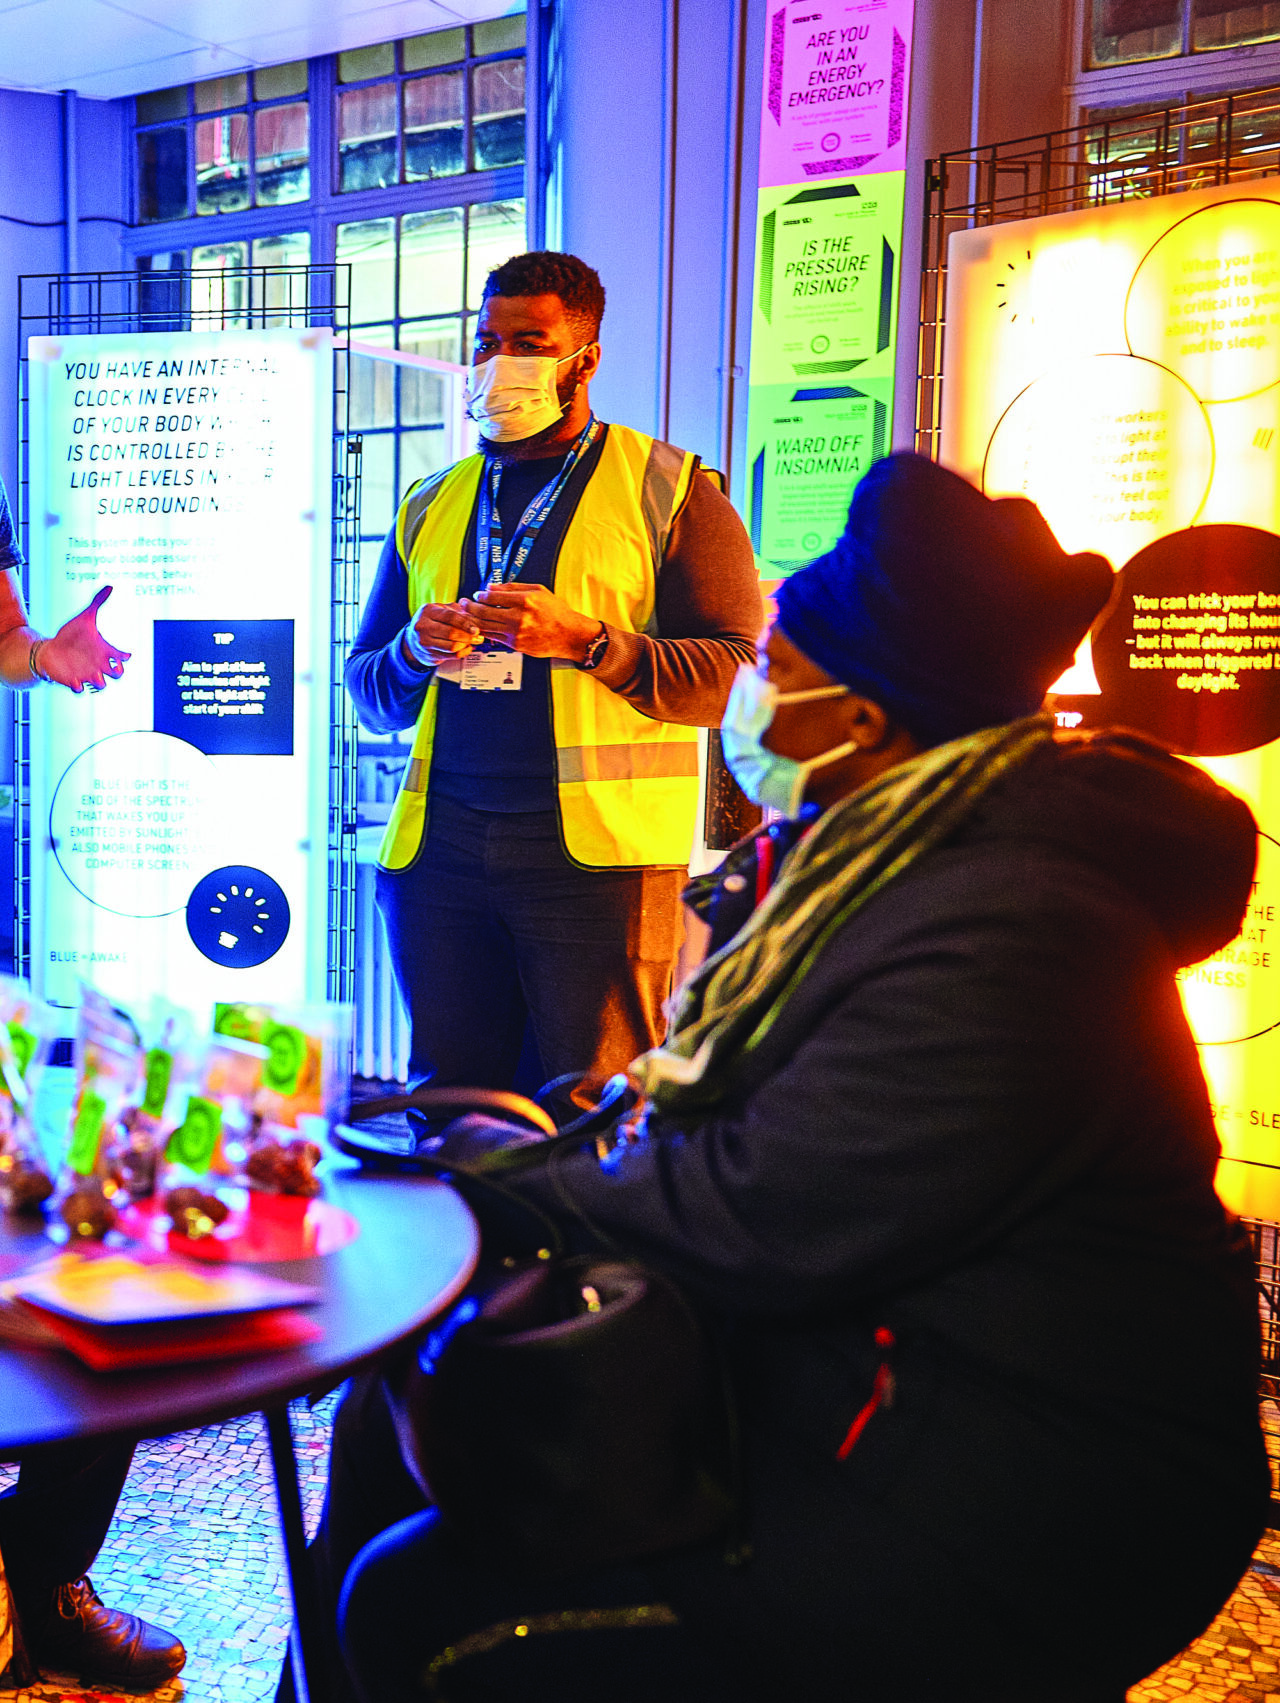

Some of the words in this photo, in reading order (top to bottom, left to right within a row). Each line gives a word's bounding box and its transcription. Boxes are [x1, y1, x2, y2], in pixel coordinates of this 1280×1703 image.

[806, 30, 836, 49] ARE
[840, 24, 870, 43] YOU
[817, 50, 834, 66] IN
[835, 46, 858, 62] AN
[808, 62, 867, 86] ENERGY
[788, 79, 884, 107] EMERGENCY?
[802, 240, 817, 256] IS
[823, 236, 854, 254] THE
[784, 254, 870, 278] PRESSURE
[1224, 255, 1250, 270] you
[792, 276, 860, 296] RISING?
[1234, 274, 1248, 286] to
[1184, 297, 1232, 314] critical
[1236, 296, 1250, 307] to
[1211, 318, 1224, 331] to
[1230, 314, 1266, 328] wake
[1180, 340, 1206, 356] and
[1209, 338, 1224, 352] to
[65, 362, 100, 380] YOU
[106, 361, 154, 378] HAVE
[156, 360, 184, 377] AN
[74, 390, 133, 406] CLOCK
[138, 388, 158, 404] IN
[163, 388, 218, 404] EVERY
[73, 417, 96, 434] OF
[102, 416, 148, 433] YOUR
[155, 415, 204, 432] BODY
[1115, 409, 1168, 423] workers
[67, 444, 83, 461] IS
[89, 442, 208, 460] CONTROLLED
[776, 436, 826, 454] WARD
[830, 434, 864, 452] OFF
[774, 456, 860, 476] INSOMNIA
[70, 471, 122, 488] LIGHT
[128, 470, 194, 486] LEVELS
[200, 469, 218, 486] IN
[1132, 470, 1142, 482] is
[98, 496, 241, 514] SURROUNDIN
[492, 546, 502, 563] NHS
[514, 546, 528, 568] NHS
[1133, 594, 1159, 610] You
[1160, 597, 1186, 610] can
[1188, 592, 1222, 610] trick
[1222, 595, 1256, 612] your
[1133, 614, 1161, 630] into
[1162, 613, 1228, 633] changing
[1228, 612, 1248, 629] its
[212, 632, 234, 644] TIP
[1136, 634, 1160, 650] but
[1161, 634, 1172, 649] it
[1173, 633, 1200, 650] will
[1201, 632, 1252, 653] always
[182, 661, 201, 672] Aim
[202, 661, 212, 672] to
[212, 661, 229, 675] get
[1130, 653, 1164, 670] back
[1164, 652, 1203, 670] when
[1204, 652, 1272, 673] triggered
[177, 675, 190, 686] 30
[1176, 672, 1240, 694] daylight.
[192, 689, 214, 700] blue
[214, 688, 238, 703] light
[183, 704, 207, 714] start
[207, 703, 218, 714] of
[218, 704, 240, 717] your
[1054, 712, 1083, 728] TIP
[158, 780, 168, 790] IS
[80, 794, 103, 806] END
[106, 794, 118, 806] OF
[123, 795, 142, 806] THE
[76, 810, 102, 821] THAT
[106, 811, 143, 822] WAKES
[146, 812, 168, 822] YOU
[170, 812, 185, 822] UP
[70, 826, 116, 837] EMITTED
[136, 827, 188, 838] SUNLIGHT
[71, 842, 99, 853] ALSO
[102, 842, 142, 854] MOBILE
[145, 844, 188, 854] PHONES
[85, 858, 144, 869] COMPUTER
[1244, 904, 1275, 922] HE
[50, 950, 78, 962] BLUE
[89, 952, 128, 963] AWAKE
